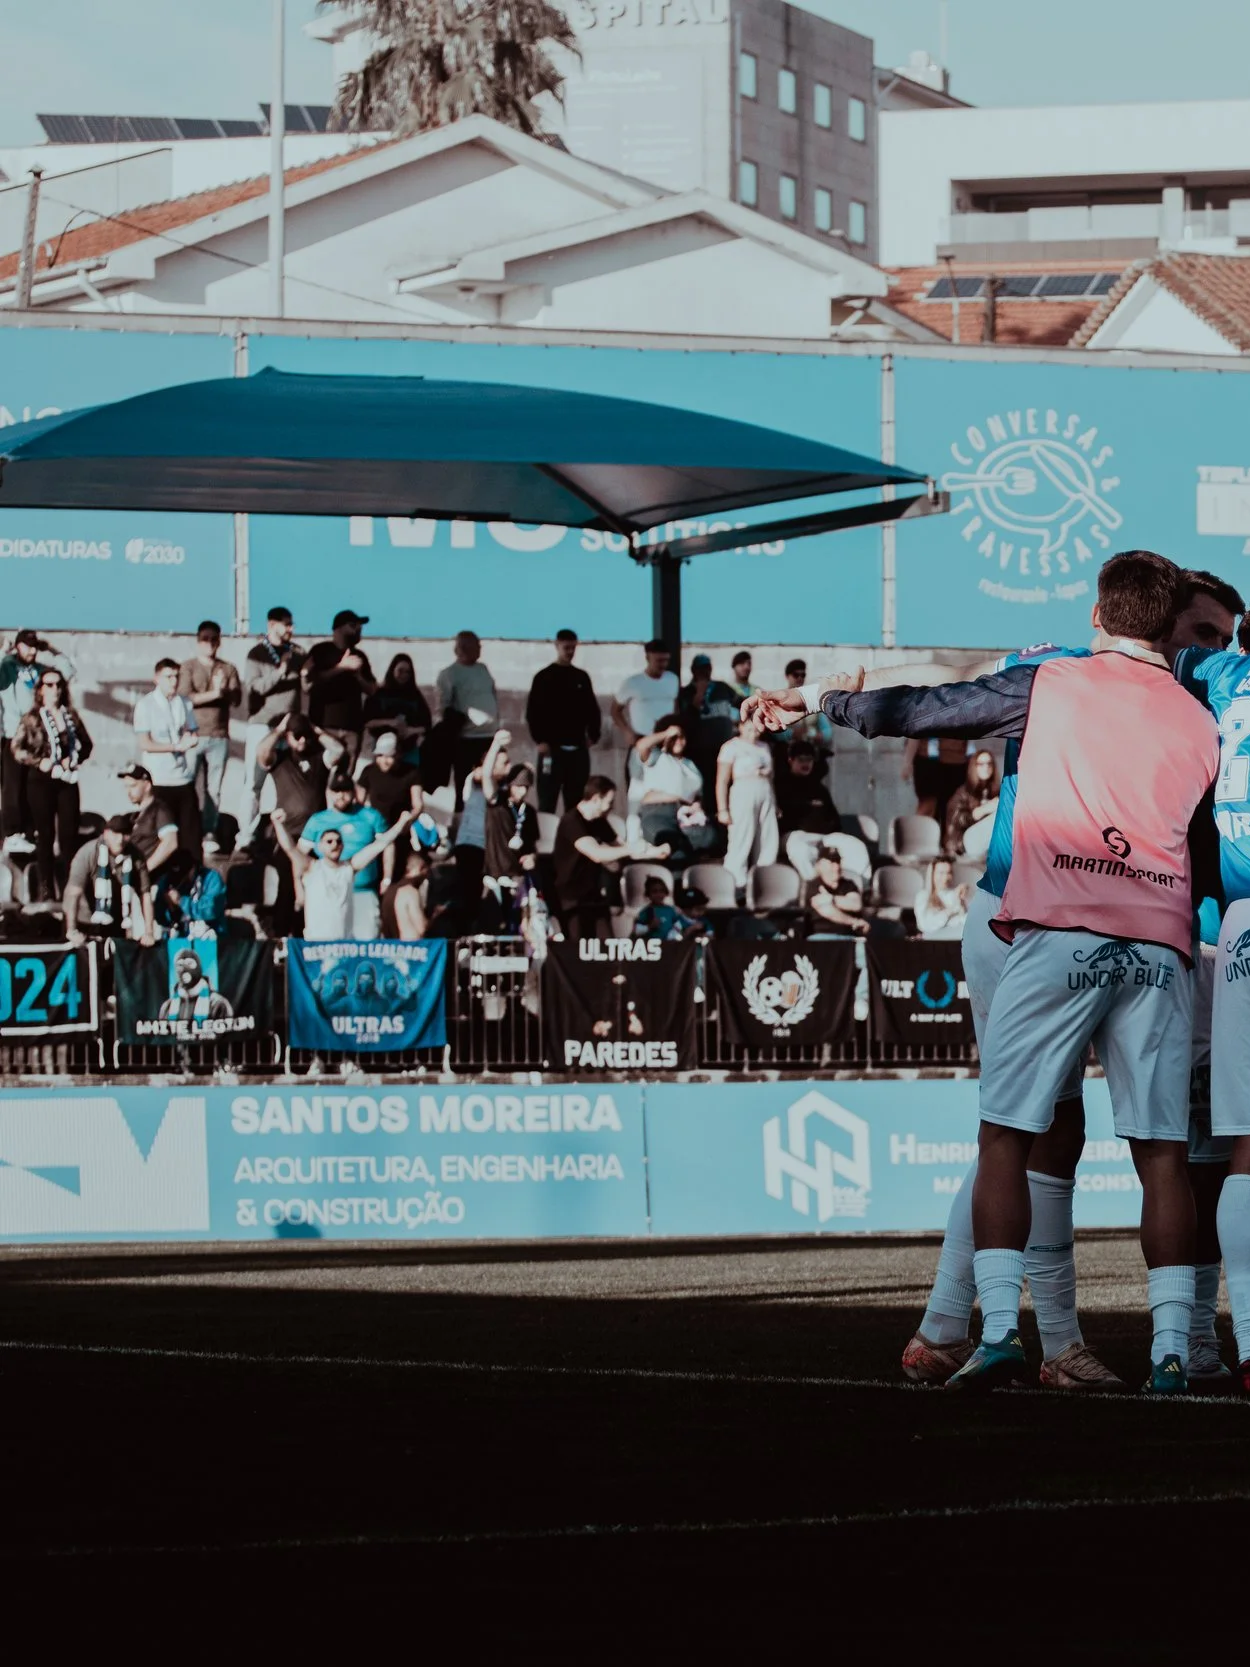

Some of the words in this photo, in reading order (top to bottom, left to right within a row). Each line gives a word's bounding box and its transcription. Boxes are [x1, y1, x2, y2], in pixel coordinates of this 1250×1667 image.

[1053, 854, 1175, 889] MARTINSPORT
[578, 937, 663, 962] ULTRAS
[1067, 965, 1129, 991] UNDER
[1134, 967, 1174, 992] BLUE
[331, 1014, 405, 1035] ULTRAS
[564, 1040, 678, 1068] PAREDES
[231, 1096, 410, 1135] SANTOS
[419, 1094, 622, 1134] MOREIRA
[234, 1156, 437, 1187] ARQUITETURA,
[441, 1154, 624, 1182] ENGENHARIA
[236, 1199, 259, 1226] &
[264, 1191, 466, 1229] CONSTRUÇÃO
